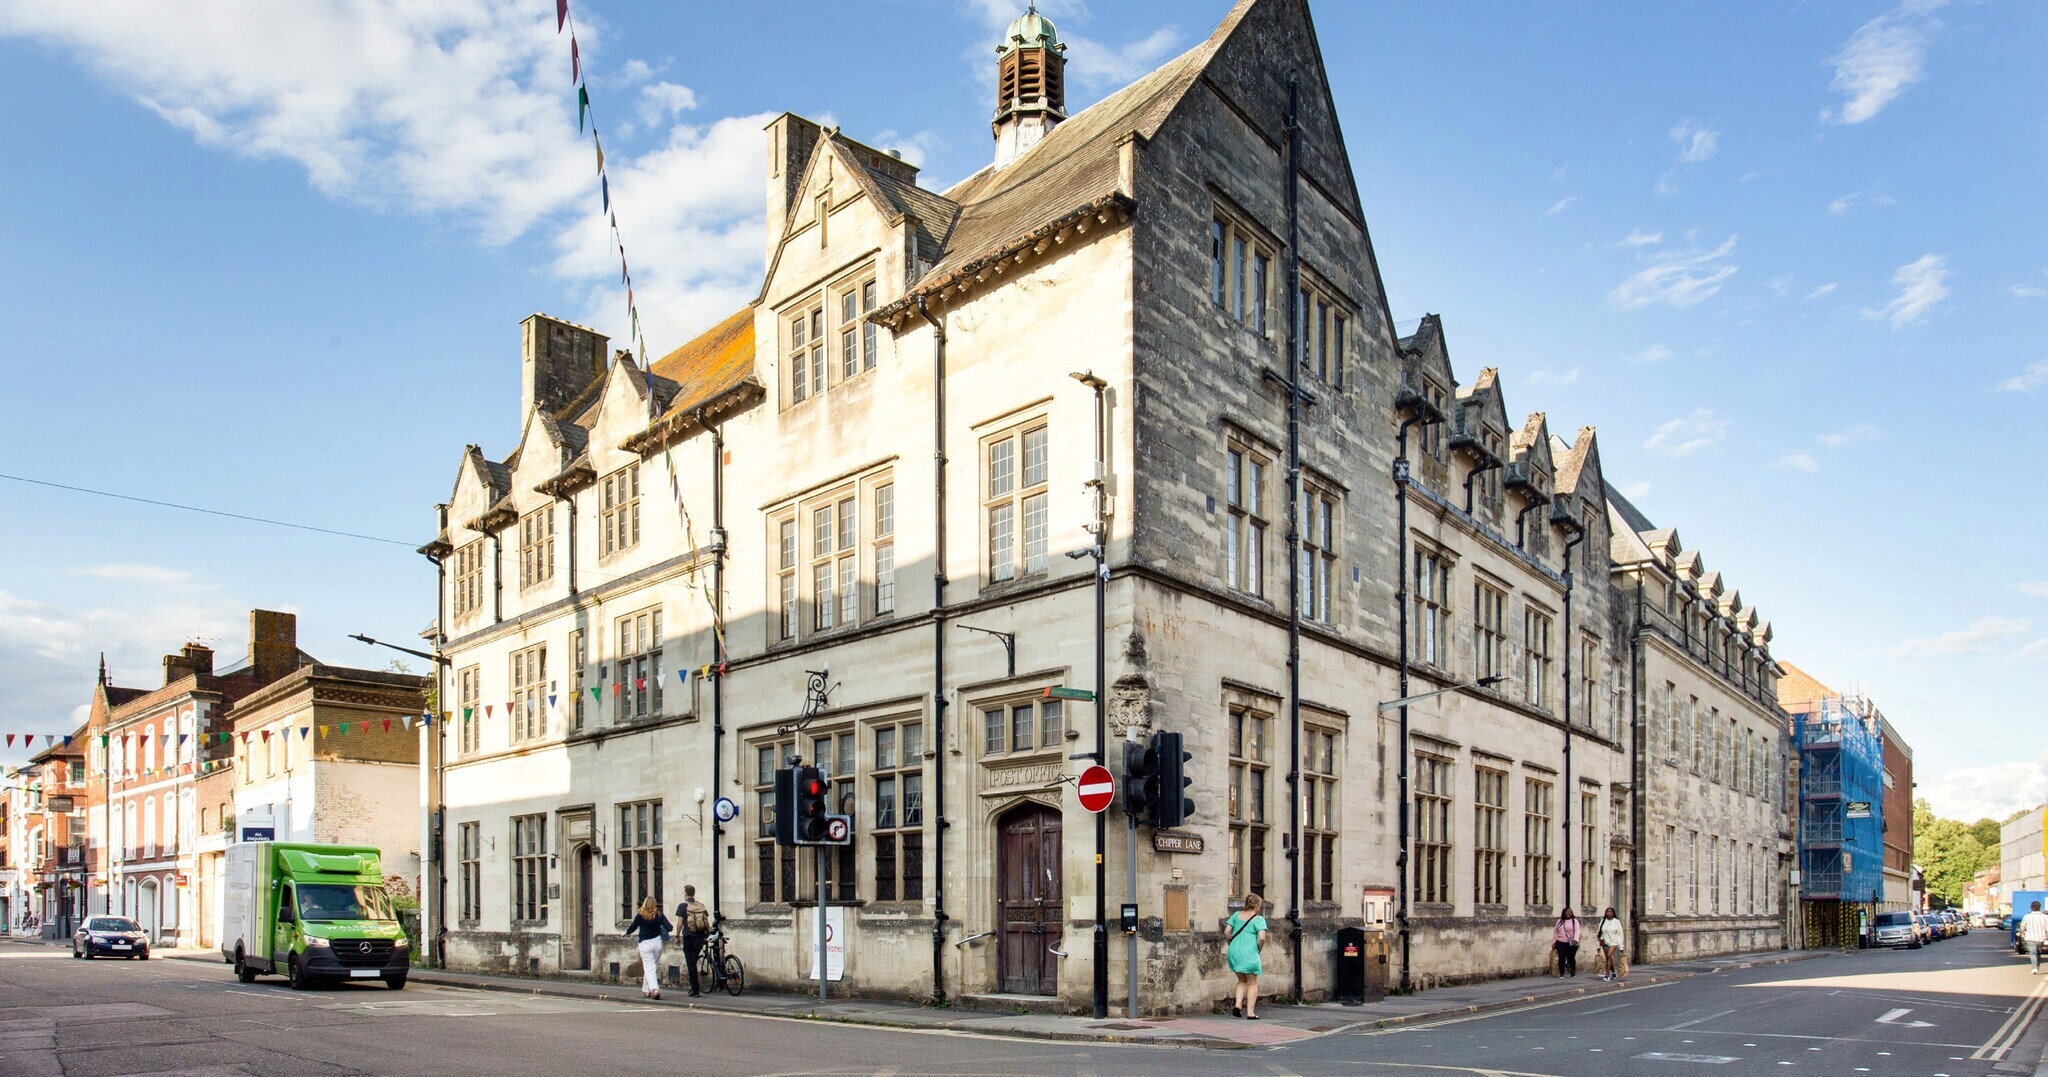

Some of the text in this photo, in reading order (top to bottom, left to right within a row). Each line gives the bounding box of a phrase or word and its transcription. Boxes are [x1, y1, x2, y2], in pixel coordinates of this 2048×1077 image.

[991, 769, 1022, 787] POST
[1158, 837, 1201, 850] CHIPPER LANE
